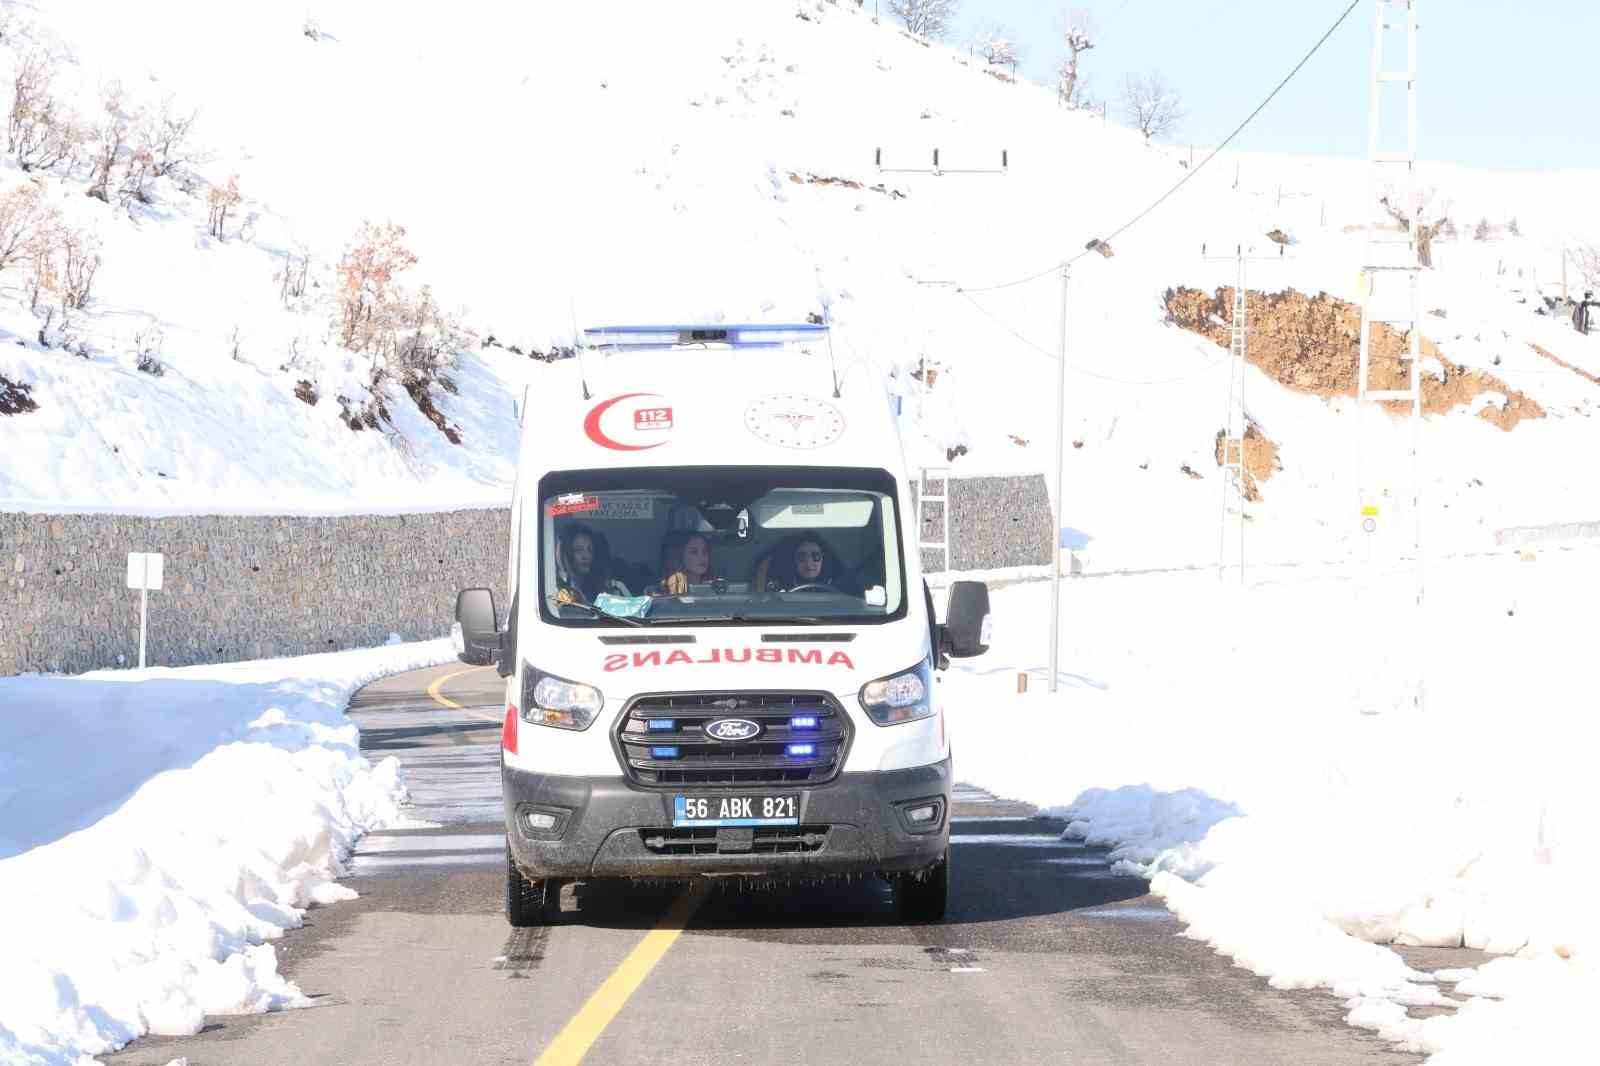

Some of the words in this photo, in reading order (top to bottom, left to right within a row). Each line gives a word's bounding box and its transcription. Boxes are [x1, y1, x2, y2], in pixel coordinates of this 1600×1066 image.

[640, 410, 668, 422] 112
[716, 722, 750, 736] Ford
[686, 798, 708, 818] 56
[719, 798, 753, 818] ABK
[763, 797, 794, 818] 821
